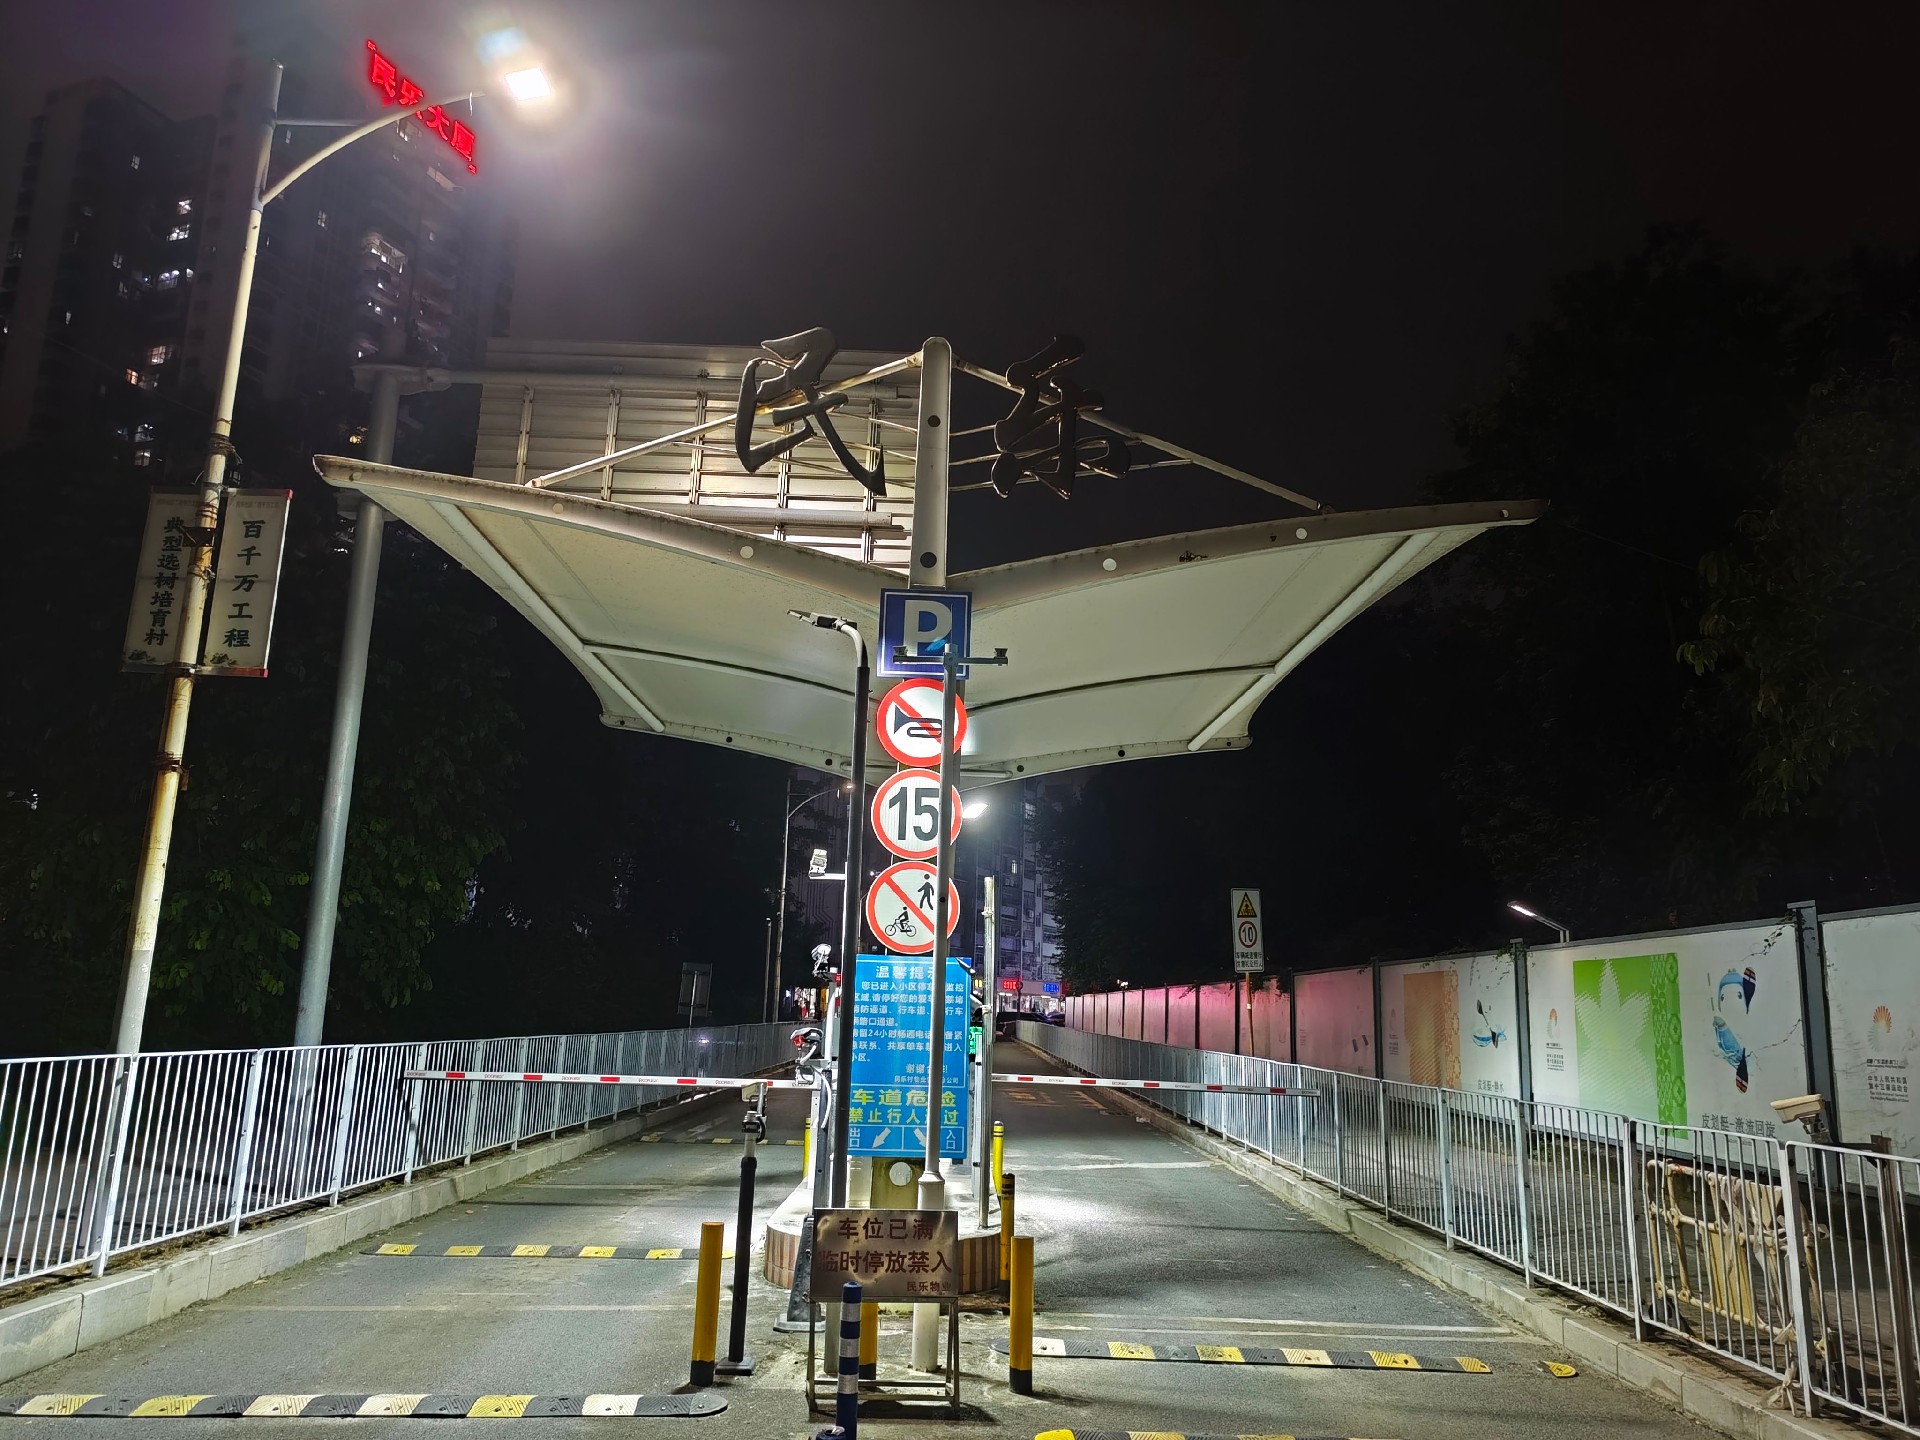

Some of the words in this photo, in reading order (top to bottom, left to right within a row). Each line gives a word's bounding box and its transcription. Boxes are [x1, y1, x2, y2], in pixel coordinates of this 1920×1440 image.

[222, 519, 266, 648] 百千万工程
[903, 599, 953, 657] P
[888, 786, 940, 842] 15
[1242, 926, 1254, 943] 10
[849, 1107, 959, 1126] 禁止行人过
[849, 1127, 861, 1148] 出口
[946, 1129, 956, 1149] 入口
[837, 1217, 935, 1240] 车位已满
[819, 1250, 953, 1274] 临时停放禁入
[906, 1281, 952, 1293] 民乐物业
